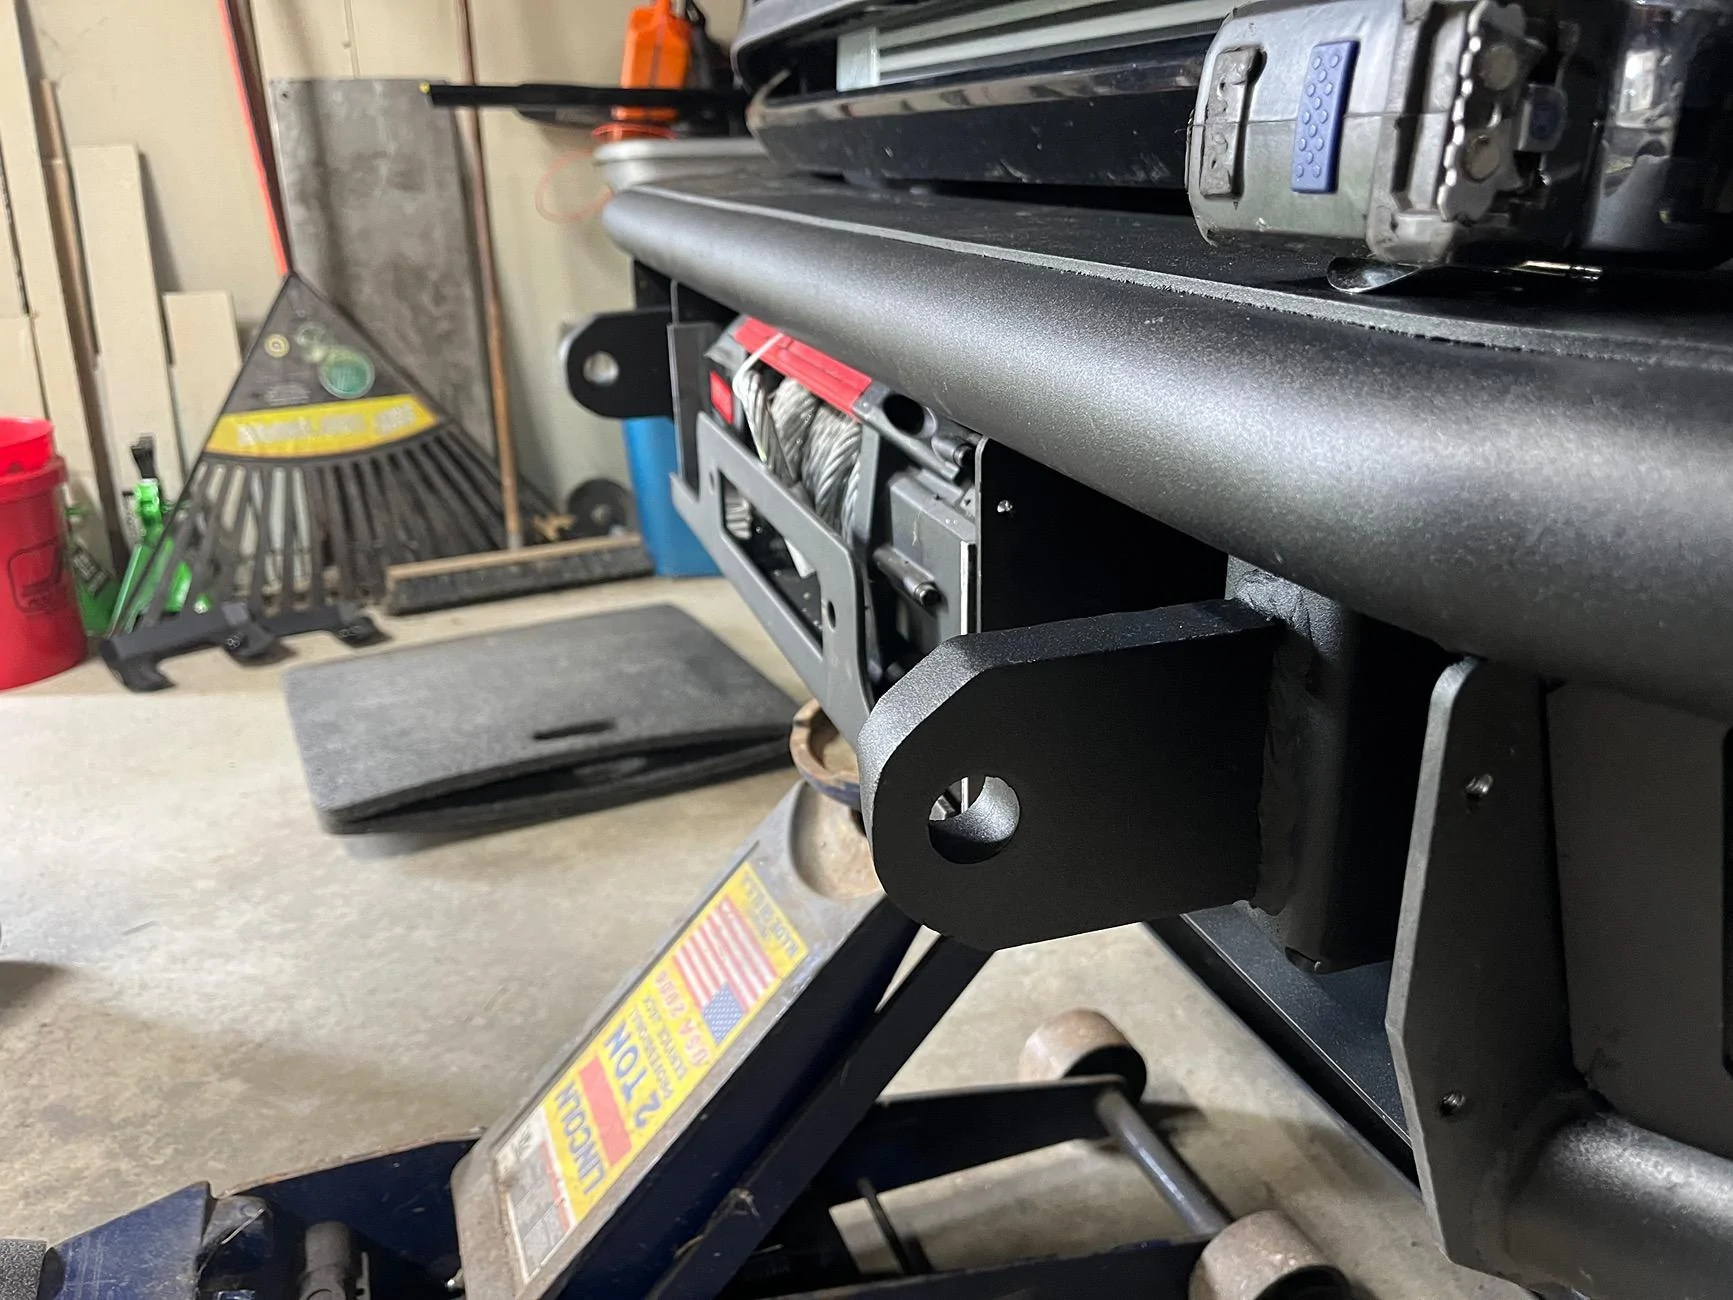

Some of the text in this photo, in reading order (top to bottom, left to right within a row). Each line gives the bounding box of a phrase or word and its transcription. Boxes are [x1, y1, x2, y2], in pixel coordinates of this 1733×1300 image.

[602, 1020, 661, 1131] 2 TON
[676, 1016, 709, 1067] USA
[553, 1080, 606, 1195] LINCOLN
